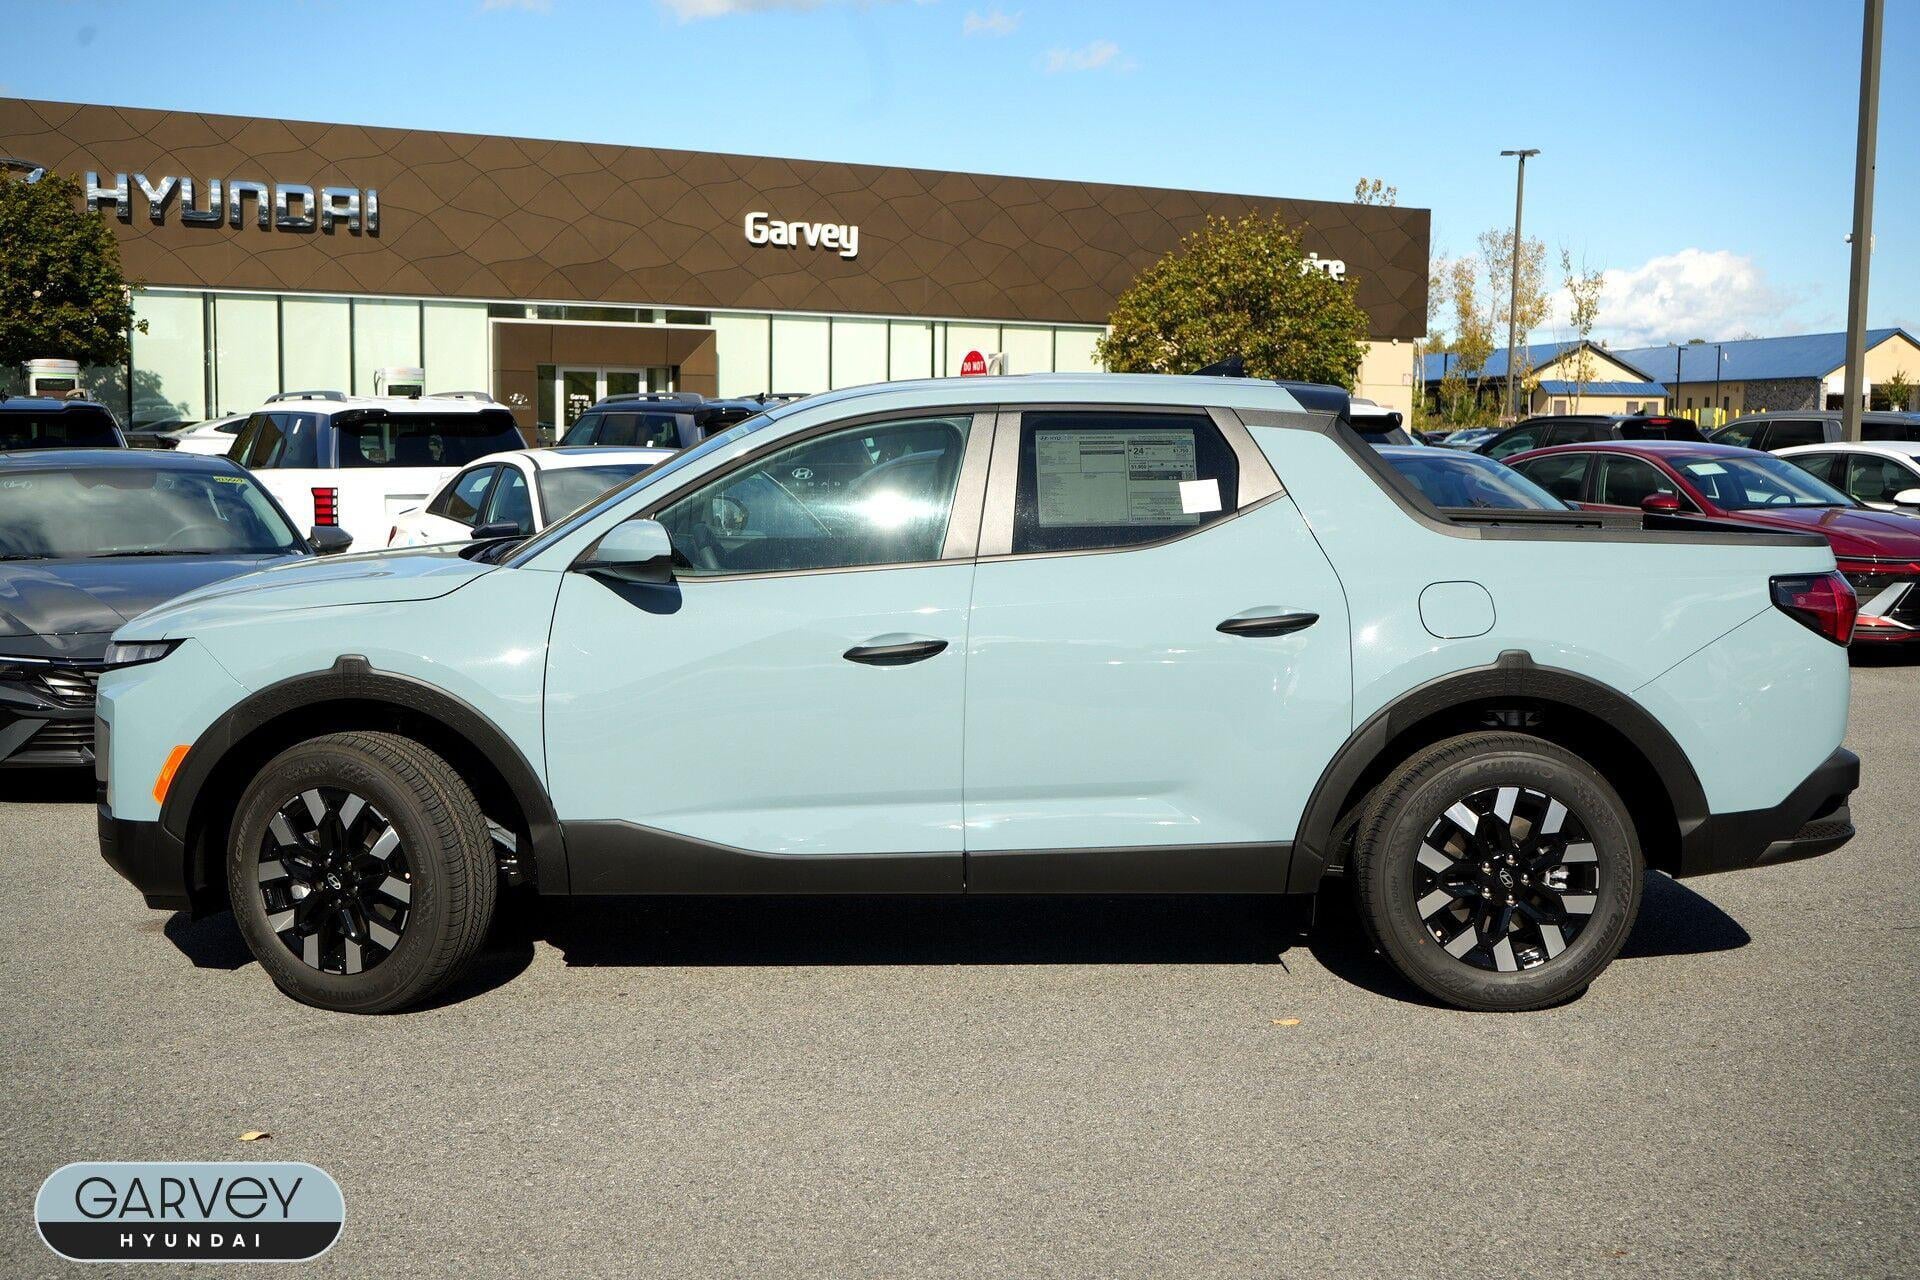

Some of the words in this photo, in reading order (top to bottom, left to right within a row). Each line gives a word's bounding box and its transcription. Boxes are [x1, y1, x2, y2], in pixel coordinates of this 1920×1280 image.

[85, 170, 378, 232] HYUNDAI
[745, 211, 859, 257] Garvey
[963, 362, 972, 372] DO
[972, 361, 984, 371] NOT
